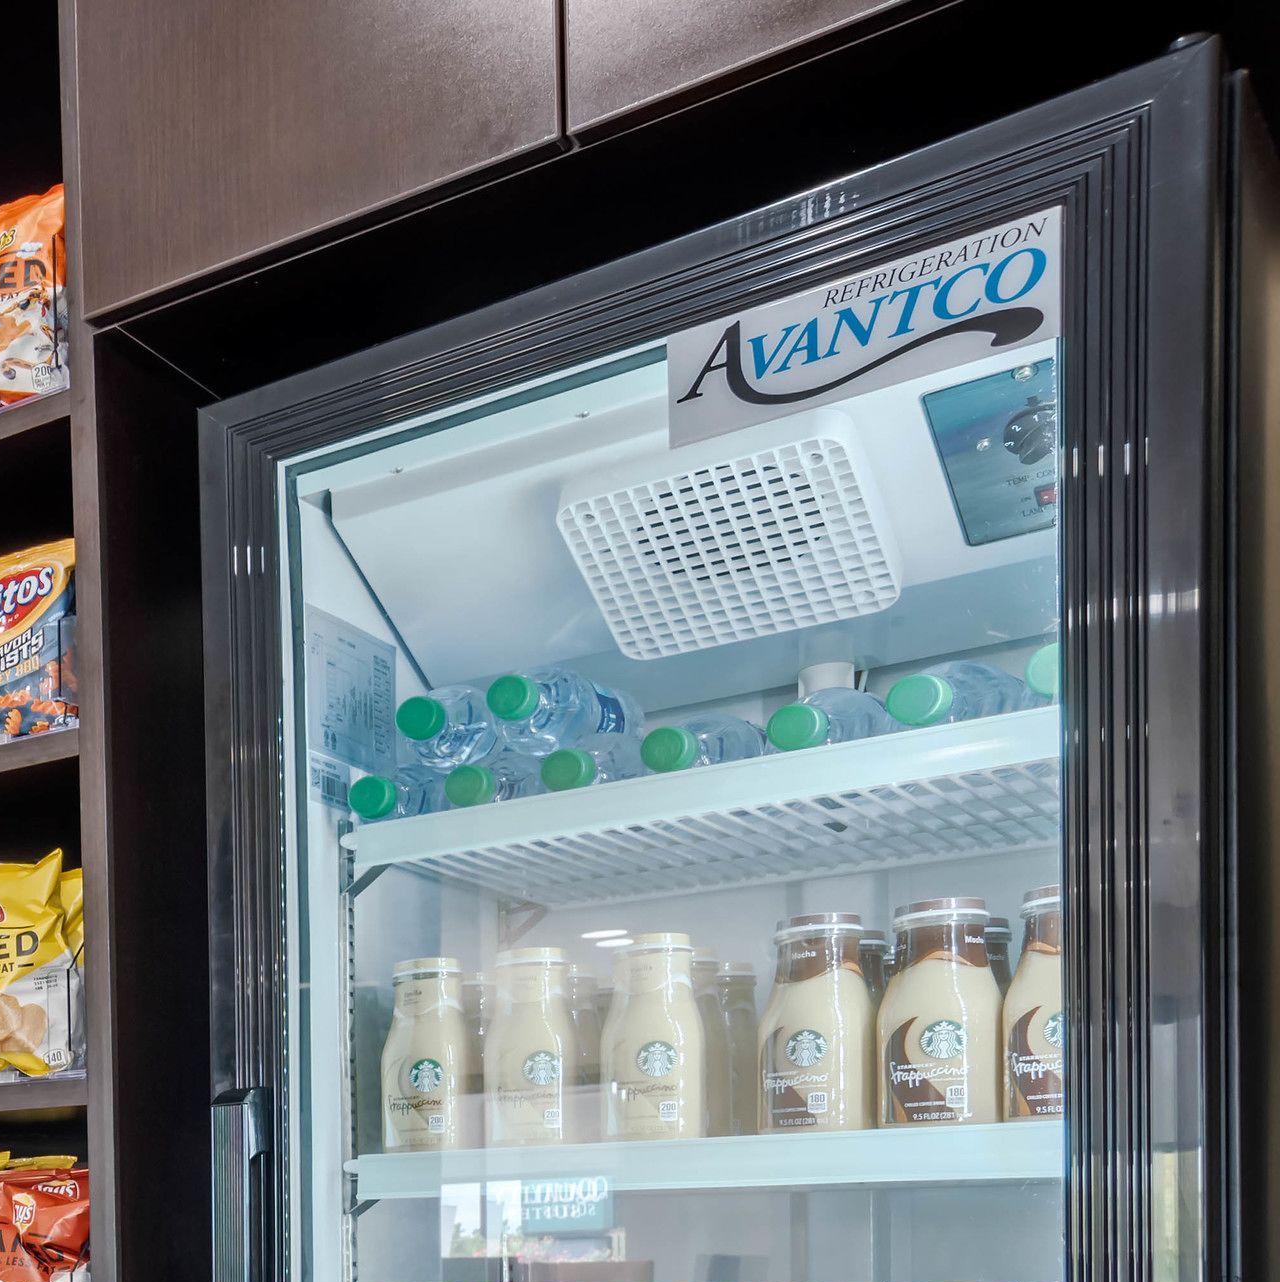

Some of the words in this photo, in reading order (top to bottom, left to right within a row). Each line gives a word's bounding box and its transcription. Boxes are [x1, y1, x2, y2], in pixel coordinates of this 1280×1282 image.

[823, 217, 1048, 308] REFRIGERATION
[677, 247, 1047, 404] AVANTCO
[791, 950, 817, 960] Mocha
[47, 1051, 62, 1064] 140
[1012, 1052, 1063, 1080] frappuc
[762, 1069, 829, 1095] frappuccino
[889, 1061, 969, 1089] frappuccino
[810, 1093, 825, 1103] 180
[950, 1087, 965, 1097] 180
